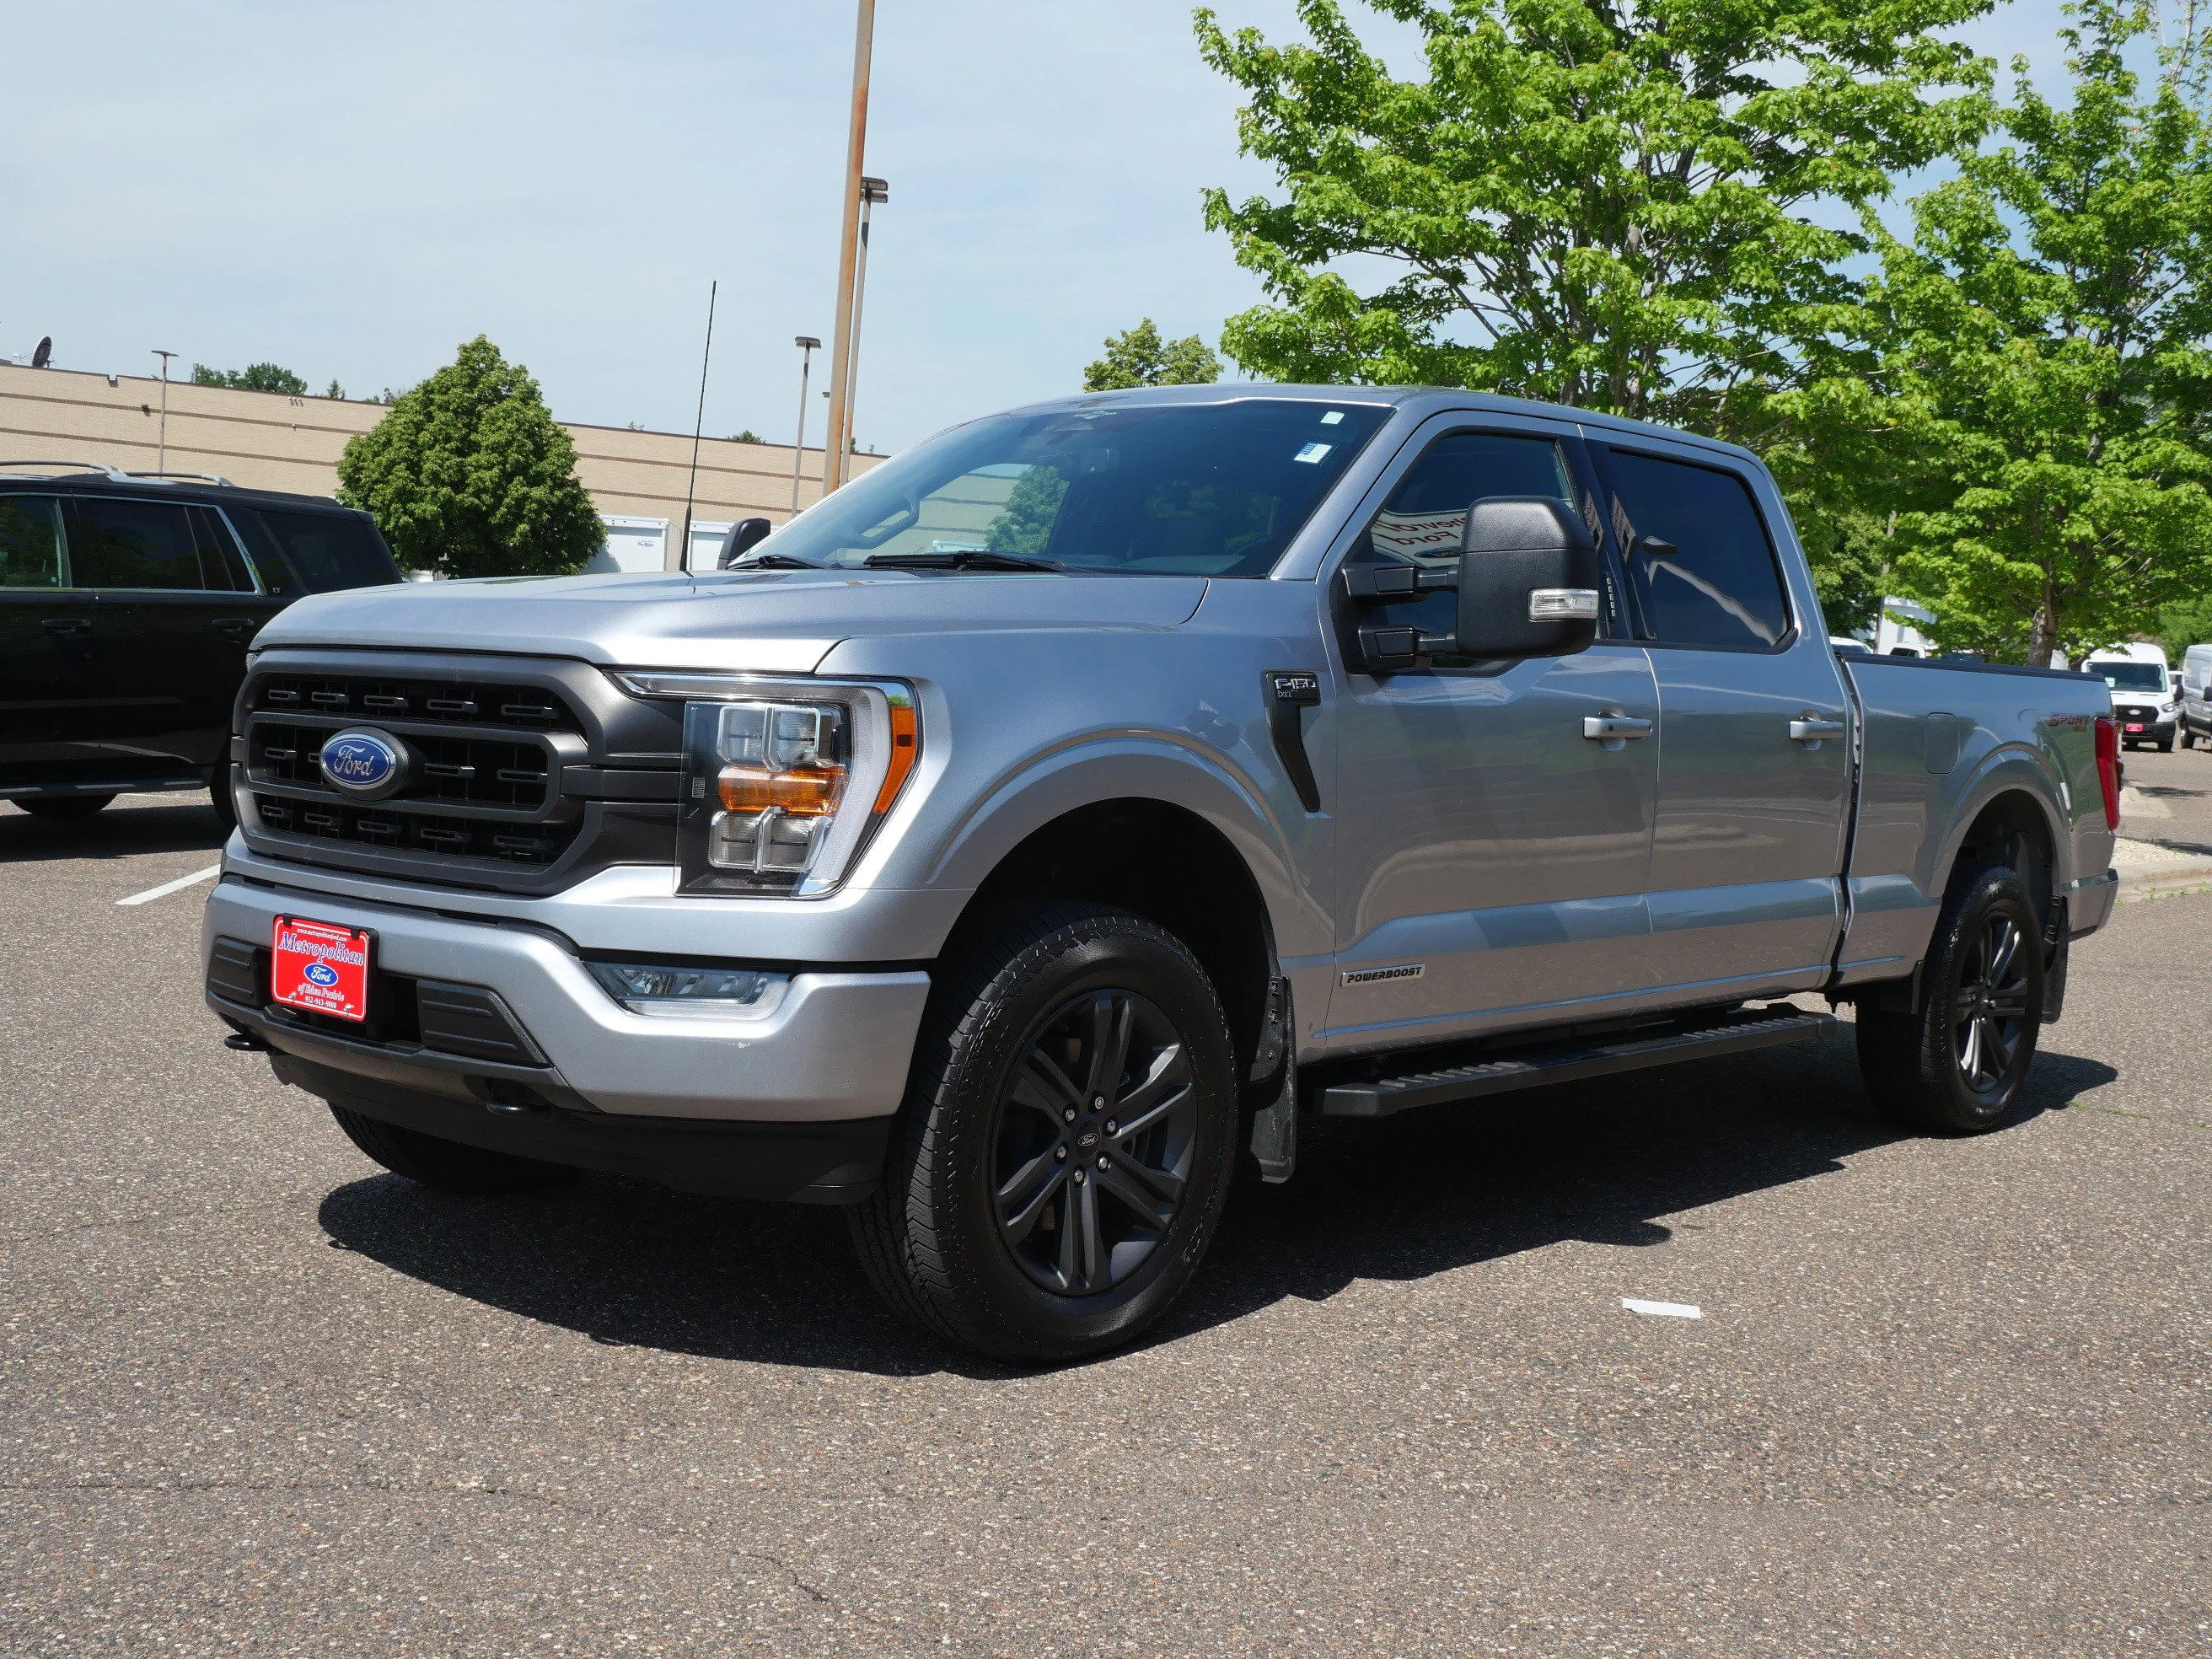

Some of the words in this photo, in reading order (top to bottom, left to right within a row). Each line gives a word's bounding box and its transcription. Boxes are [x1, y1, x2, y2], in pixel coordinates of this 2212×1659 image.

[333, 744, 375, 776] Ford
[277, 931, 364, 966] Metropolitan
[310, 966, 331, 982] Ford
[1346, 966, 1422, 984] POWERBOOST
[1082, 1135, 1097, 1145] Ford
